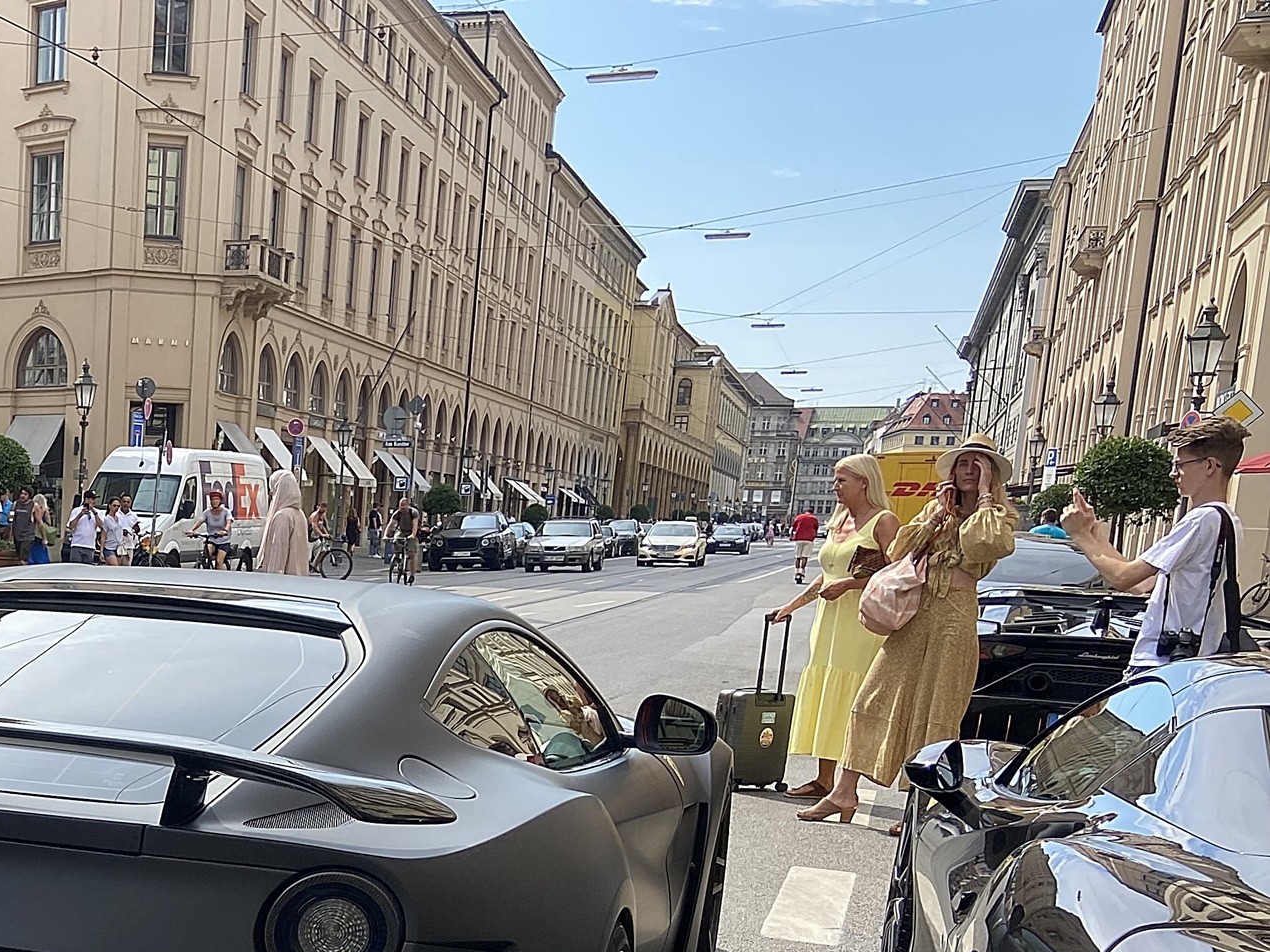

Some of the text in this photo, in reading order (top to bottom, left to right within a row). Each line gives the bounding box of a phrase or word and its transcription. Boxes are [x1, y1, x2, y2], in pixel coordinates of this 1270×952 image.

[131, 337, 189, 346] MARNI
[1046, 450, 1055, 466] P
[890, 482, 938, 497] DH
